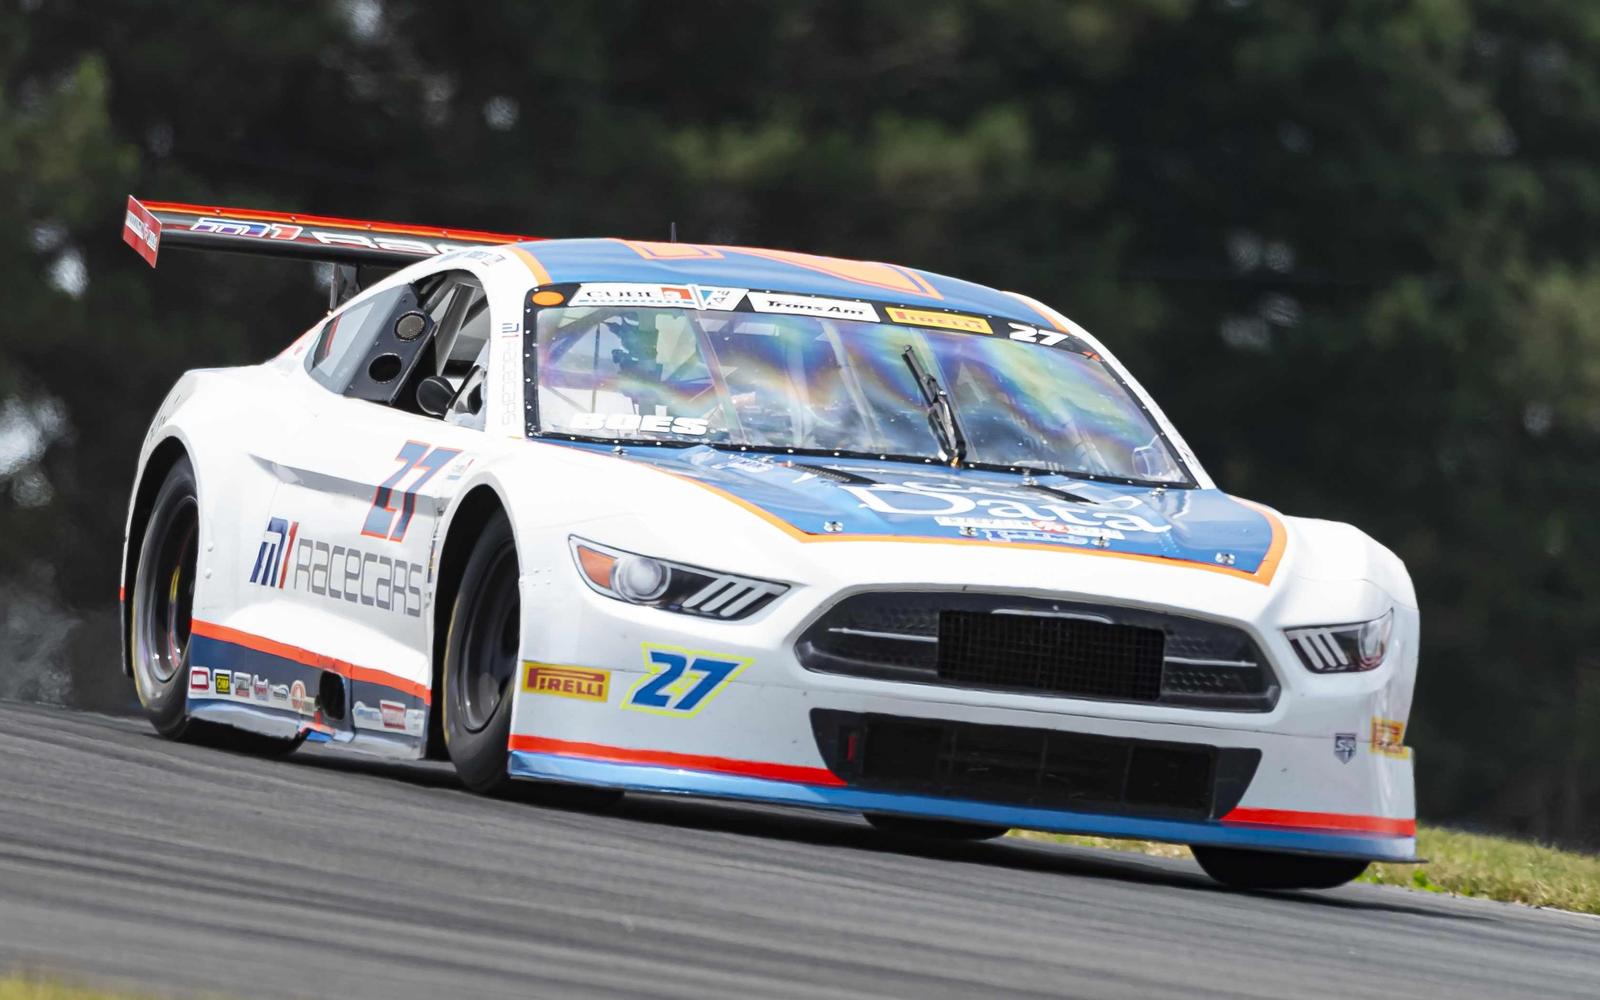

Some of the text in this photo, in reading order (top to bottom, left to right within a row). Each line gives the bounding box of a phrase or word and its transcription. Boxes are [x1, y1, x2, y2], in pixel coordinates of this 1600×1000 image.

[767, 300, 865, 316] Trans Am
[1007, 322, 1069, 347] 27
[360, 439, 464, 544] 27
[839, 483, 1173, 534] Data
[526, 665, 606, 697] PIRELLI
[629, 649, 741, 711] 27
